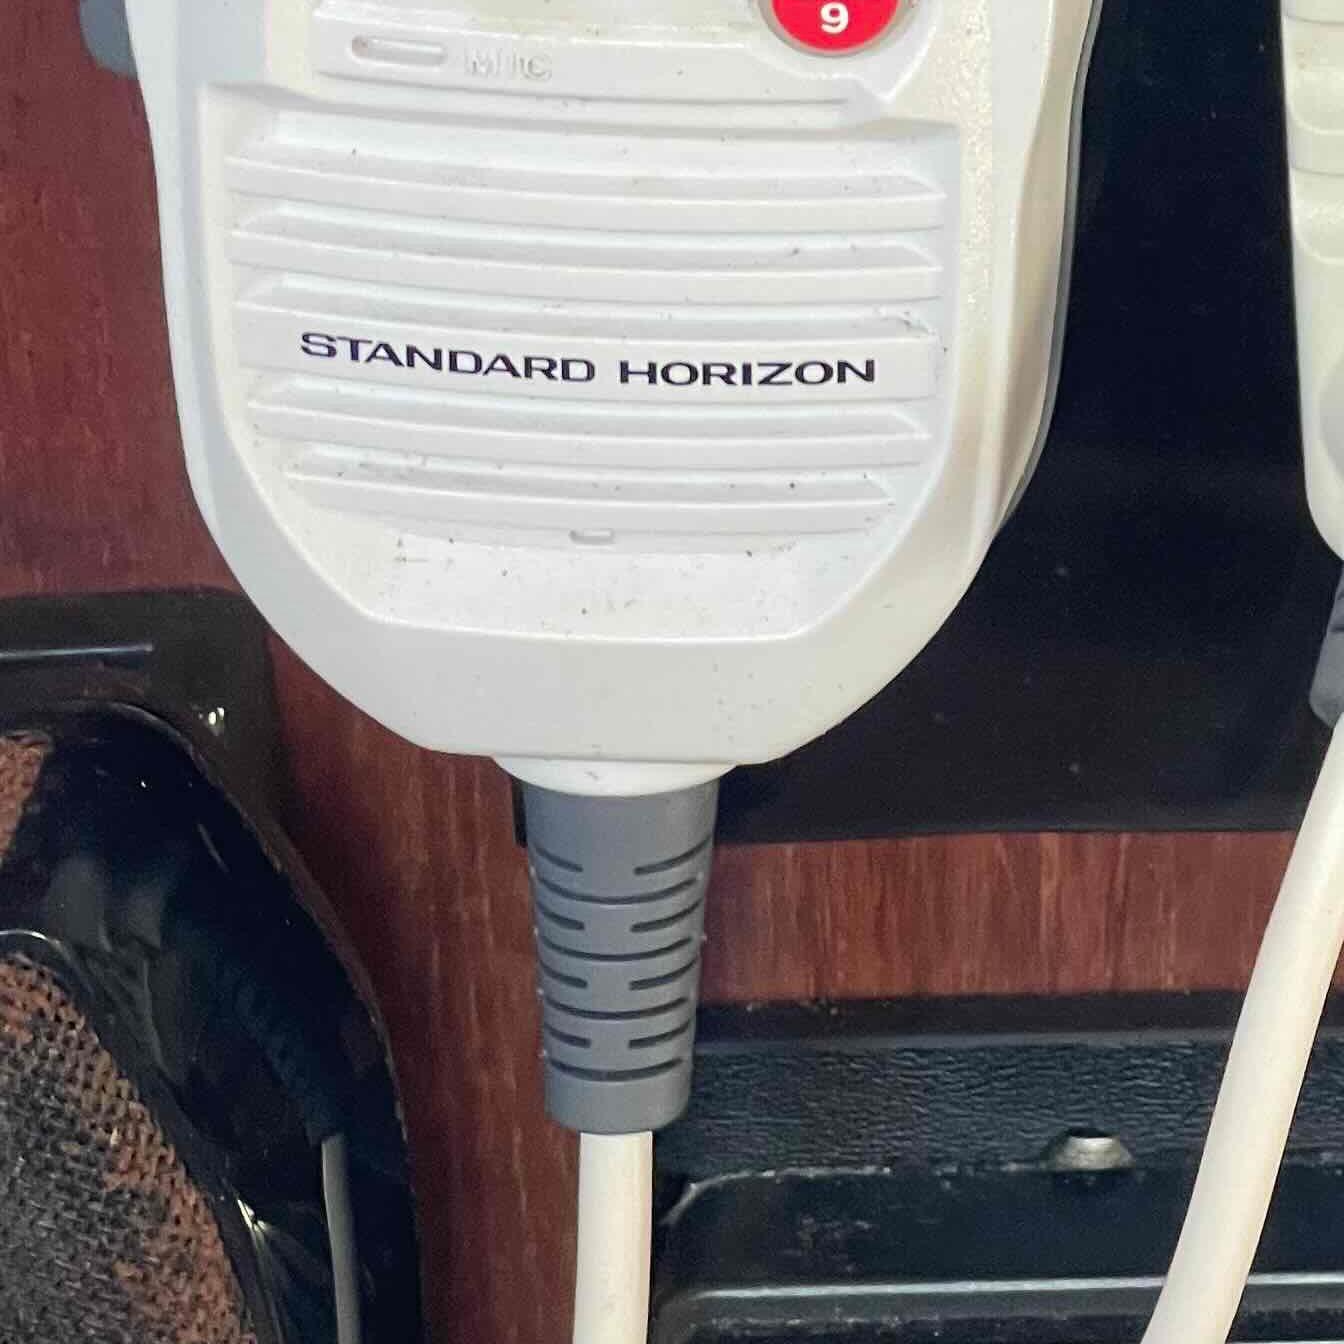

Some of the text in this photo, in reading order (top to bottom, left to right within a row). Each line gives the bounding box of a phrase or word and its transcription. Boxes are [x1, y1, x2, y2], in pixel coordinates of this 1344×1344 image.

[820, 3, 850, 35] 9
[300, 332, 875, 386] STANDARD HORIZON
